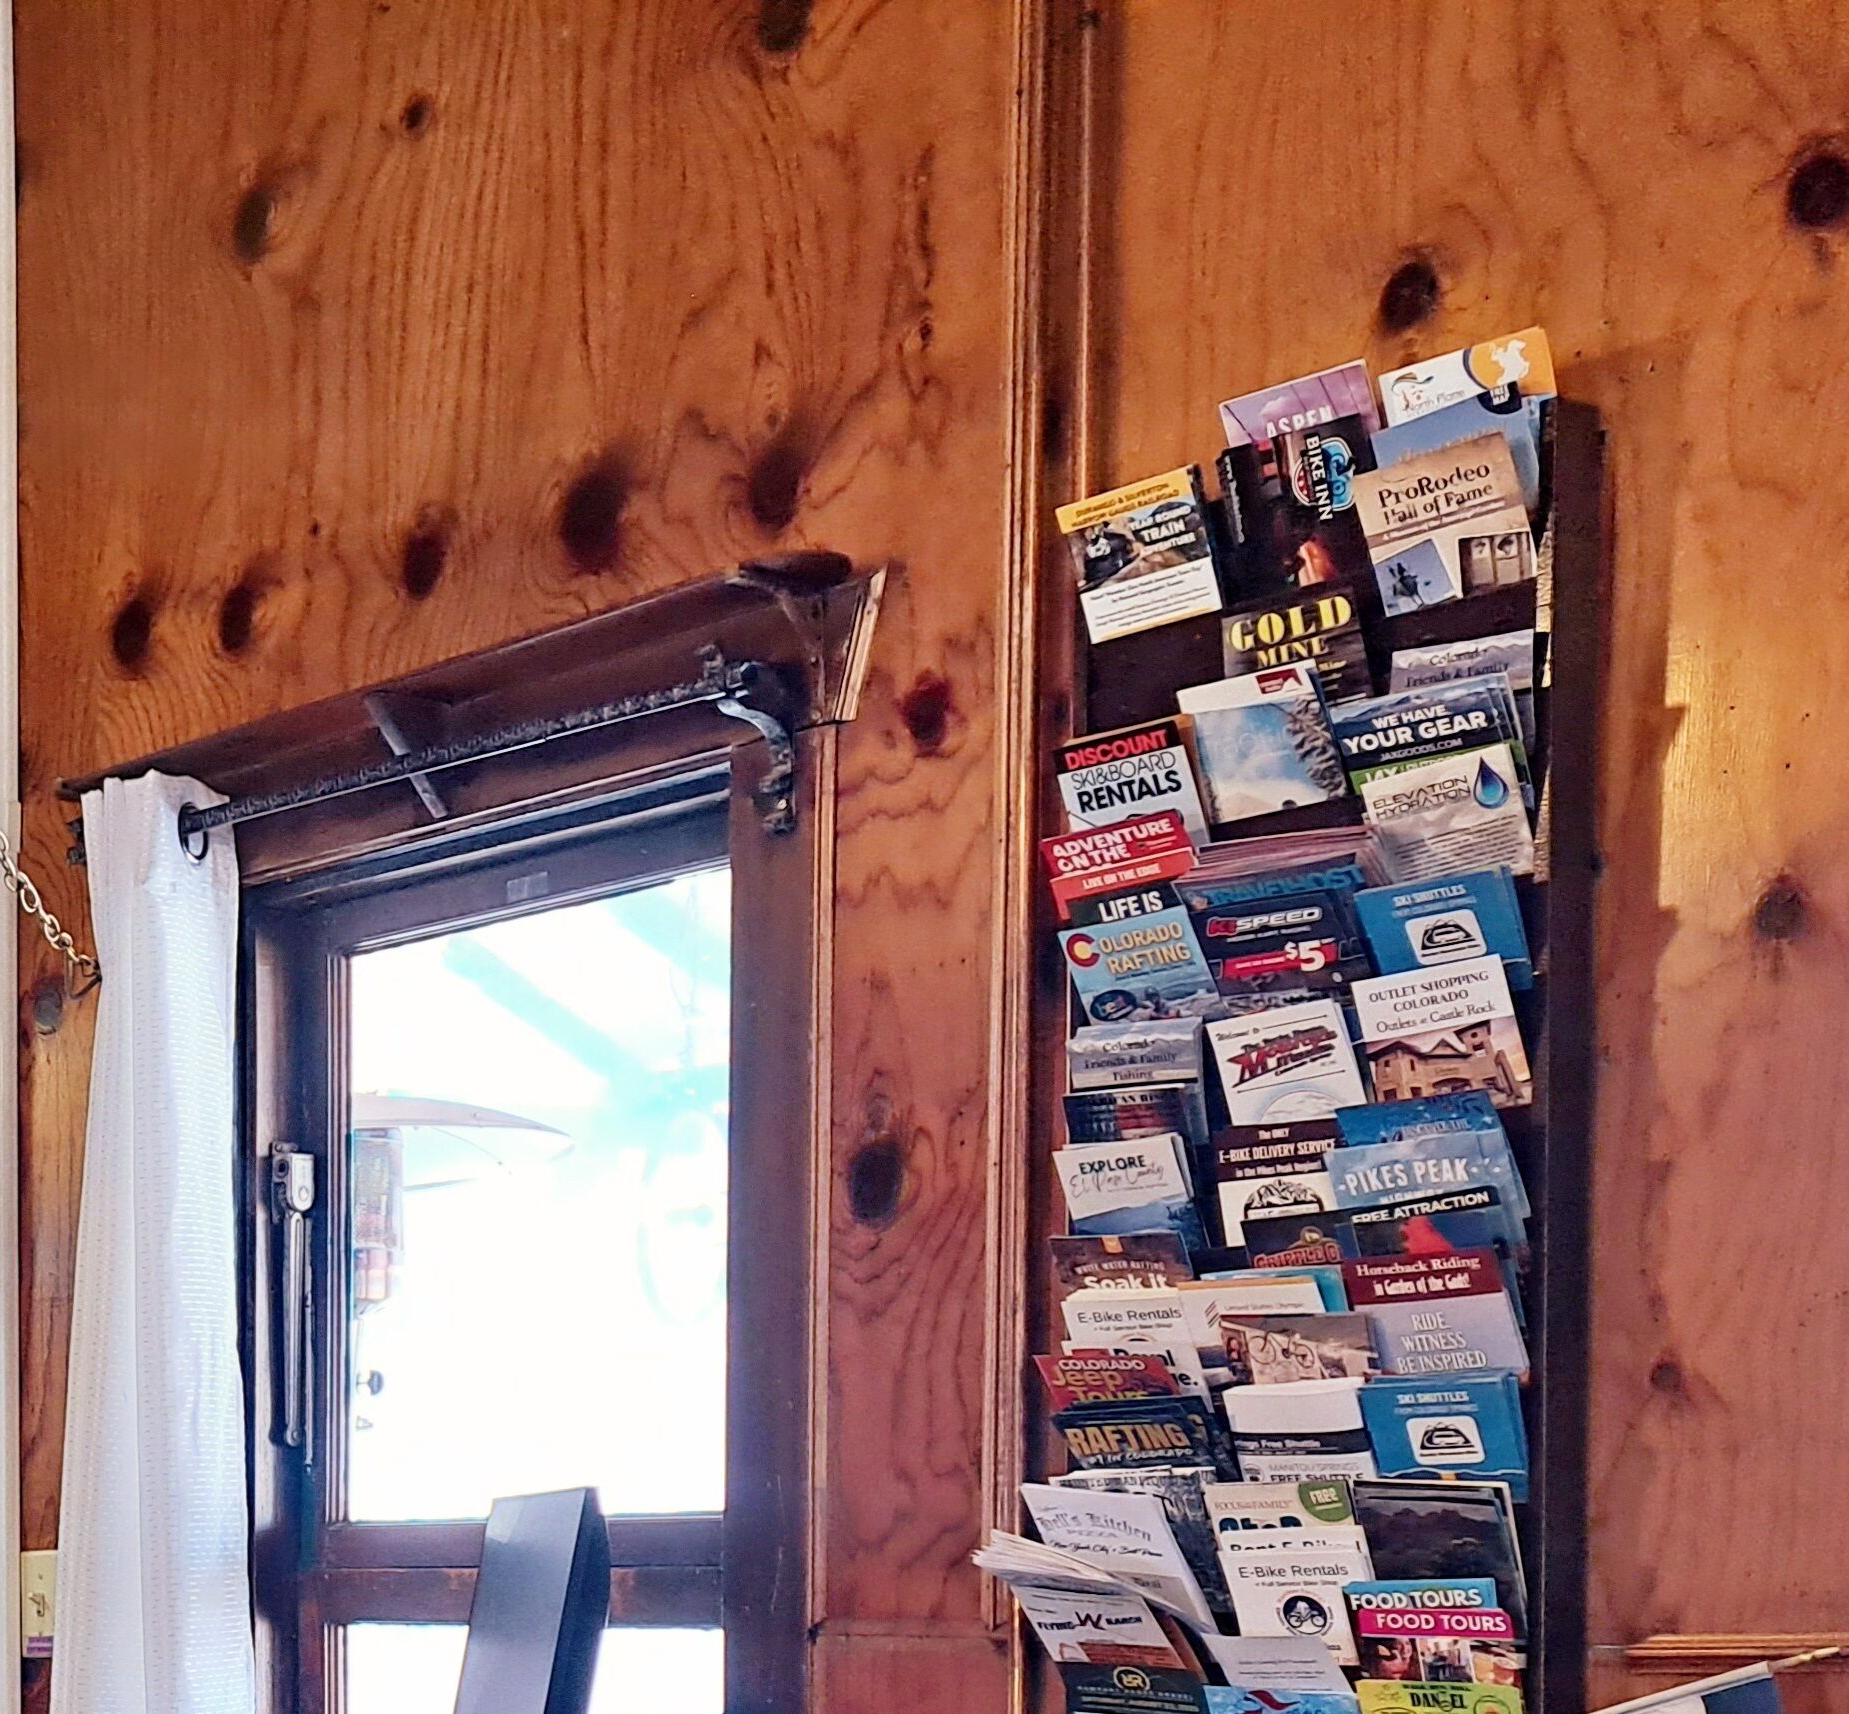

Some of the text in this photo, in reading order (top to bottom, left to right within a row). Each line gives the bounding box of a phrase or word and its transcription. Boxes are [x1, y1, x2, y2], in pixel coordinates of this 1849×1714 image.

[1265, 404, 1335, 437] ASPEN
[1305, 434, 1334, 521] BIKE INN
[1378, 464, 1490, 508] ProRodeo
[1384, 503, 1418, 526] Hall
[1422, 496, 1442, 514] of
[1444, 483, 1494, 507] Fame
[1140, 519, 1186, 543] TRAIN
[1230, 595, 1352, 652] GOLD
[1256, 636, 1330, 668] MINE
[1372, 704, 1447, 729] WE HAVE
[1343, 710, 1489, 754] YOUR GEAR
[1064, 729, 1169, 770] DISCOUNT
[1070, 751, 1177, 791] SKI&BOARD
[1076, 770, 1183, 814] RENTALS
[1373, 775, 1469, 810] ELEVATION
[1375, 785, 1472, 819] HYDRATION
[1052, 818, 1175, 858] ADVENTURE
[1057, 845, 1132, 872] ON THE
[1097, 890, 1165, 923] LIFE IS
[1236, 907, 1322, 932] SPEED
[1107, 942, 1192, 975] RAFTING
[1284, 938, 1327, 973] $5
[1369, 970, 1490, 1003] OUTLET SHOPPING
[1393, 988, 1470, 1013] COLORADO
[1429, 1009, 1465, 1024] Castle
[1466, 1001, 1496, 1015] Rock
[1128, 1055, 1139, 1065] &
[1140, 1051, 1178, 1066] Family
[1252, 1142, 1296, 1161] DELIVERY
[1297, 1138, 1336, 1156] SERVICE
[1078, 1155, 1147, 1175] EXPLORE
[1344, 1162, 1409, 1197] PIKES
[1413, 1157, 1469, 1185] PEAK
[1351, 1208, 1392, 1224] FREE
[1394, 1190, 1491, 1218] ATTRACTION
[1356, 1256, 1482, 1277] Horseback Riding
[1083, 1272, 1169, 1290] Soak it
[1077, 1306, 1184, 1325] E-Bike Rentals
[1411, 1311, 1450, 1332] RIDE
[1401, 1331, 1467, 1353] WITNESS
[1057, 1358, 1147, 1372] COLORADO
[1397, 1350, 1488, 1375] BE INSPIRED
[1053, 1365, 1125, 1391] Jeep
[1064, 1423, 1192, 1459] RAFTING
[1309, 1487, 1339, 1504] FREE
[1036, 1511, 1152, 1542] Hell's Kitchen
[1238, 1563, 1349, 1579] E-Bike Rentals
[1351, 1588, 1483, 1611] FOOD TOURS
[1074, 1611, 1107, 1631] W
[1375, 1613, 1508, 1632] FOOD TOURS
